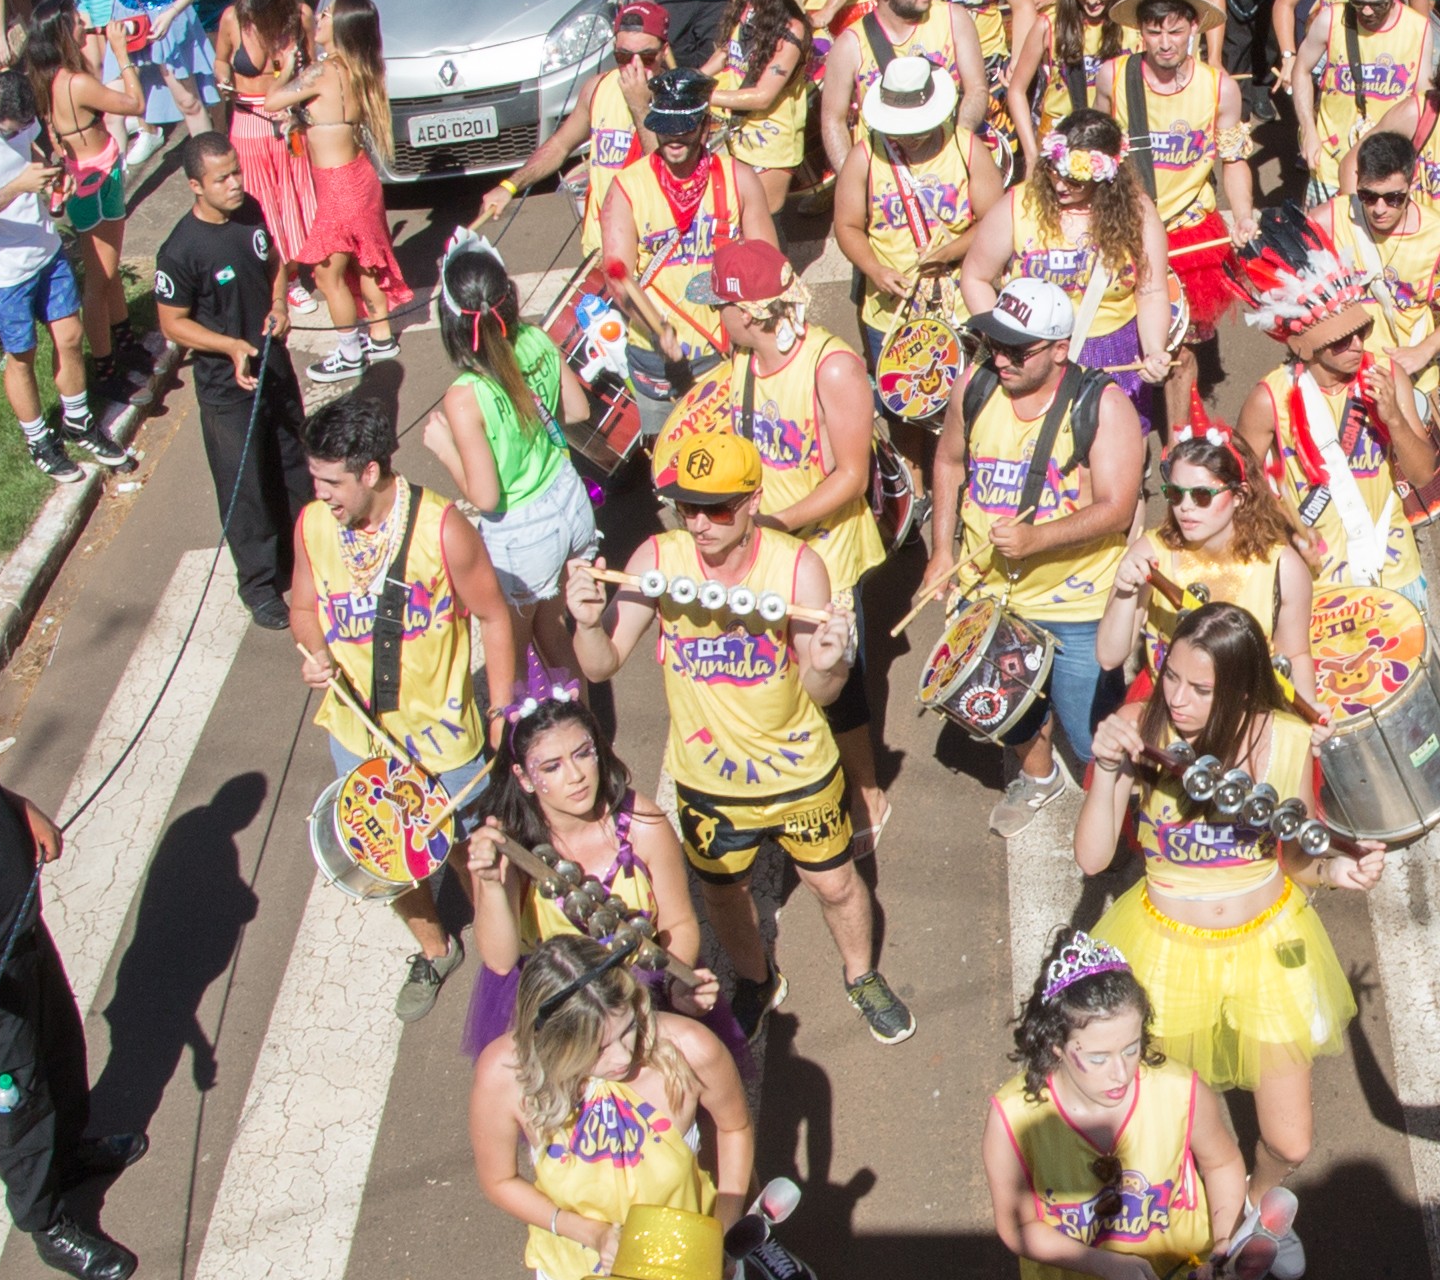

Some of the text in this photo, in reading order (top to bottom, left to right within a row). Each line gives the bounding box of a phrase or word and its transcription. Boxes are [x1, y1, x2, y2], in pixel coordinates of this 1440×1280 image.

[1049, 248, 1078, 270] OI
[995, 462, 1022, 486] OI
[696, 636, 729, 659] OI
[688, 641, 774, 679] Sumida
[343, 802, 394, 879] Sumida
